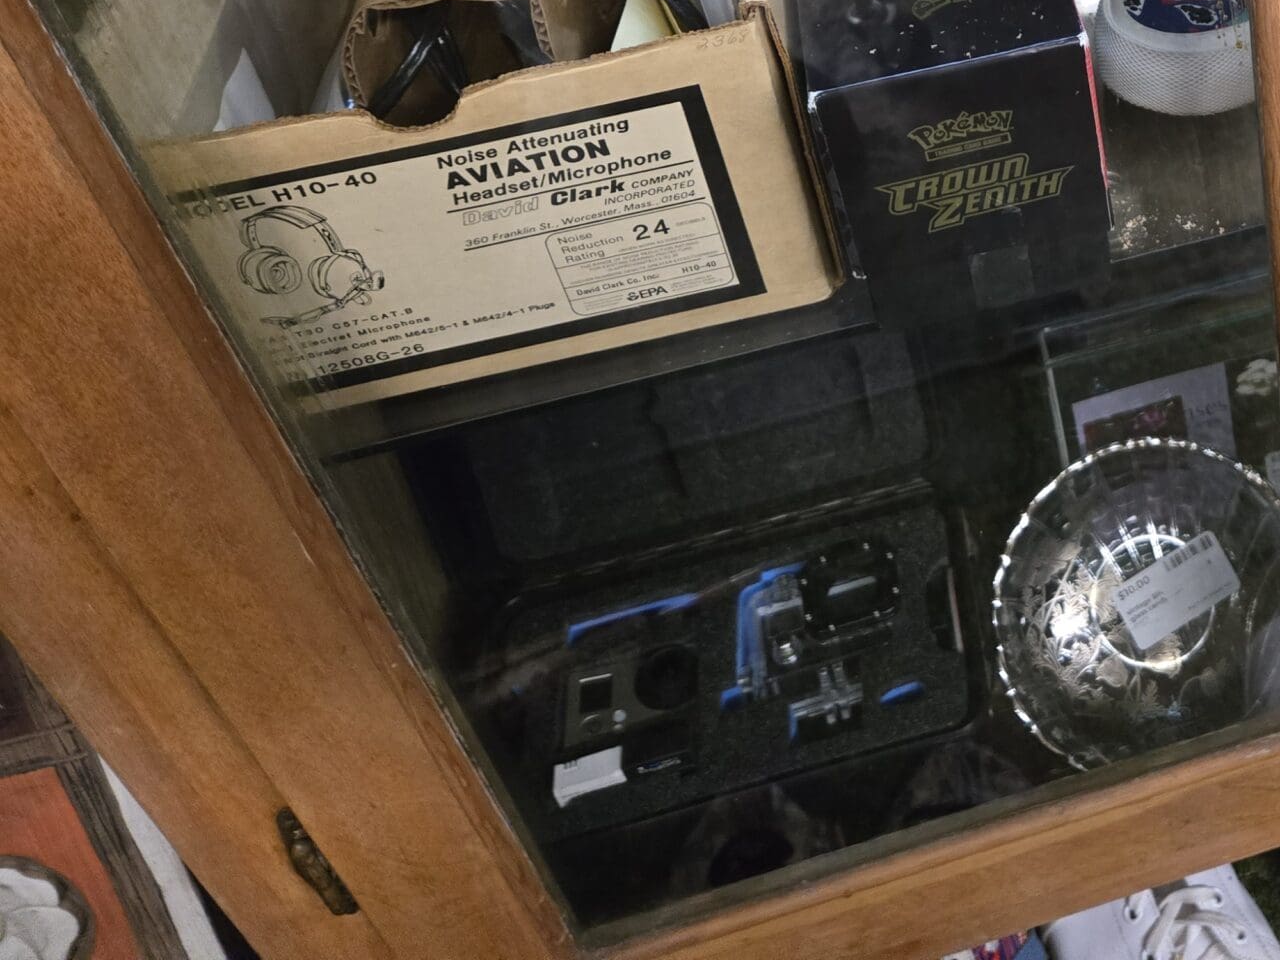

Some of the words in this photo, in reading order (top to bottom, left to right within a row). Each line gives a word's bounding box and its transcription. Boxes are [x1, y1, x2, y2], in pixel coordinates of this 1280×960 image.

[437, 145, 498, 170] Noise
[507, 118, 630, 155] Attenuating
[447, 138, 611, 190] AVIATION
[453, 148, 672, 206] Headset/Microphone
[178, 194, 265, 219] OEL
[274, 171, 378, 204] H10-40
[462, 197, 539, 226] David
[550, 179, 627, 207] Clark
[631, 168, 695, 190] COMPANY
[604, 179, 696, 206] INCORPORATED
[878, 155, 1028, 215] CROWN
[926, 166, 1073, 231] ZENITH
[465, 235, 489, 248] 360
[492, 224, 537, 242] Franklin
[661, 190, 696, 204] 01604
[632, 218, 670, 241] 24
[557, 232, 593, 245] Noise
[561, 234, 624, 255] Reduction
[564, 249, 606, 265] Rating
[681, 260, 717, 274] H10-40
[576, 286, 600, 297] David
[601, 280, 624, 292] Clark
[627, 278, 641, 286] Co.
[639, 285, 669, 300] EPA
[352, 339, 378, 353] Cord
[380, 334, 402, 344] with
[528, 300, 557, 315] Plugs
[357, 315, 432, 337] Microphone
[317, 342, 425, 376] 12508G-26
[1118, 575, 1151, 601] $10.00
